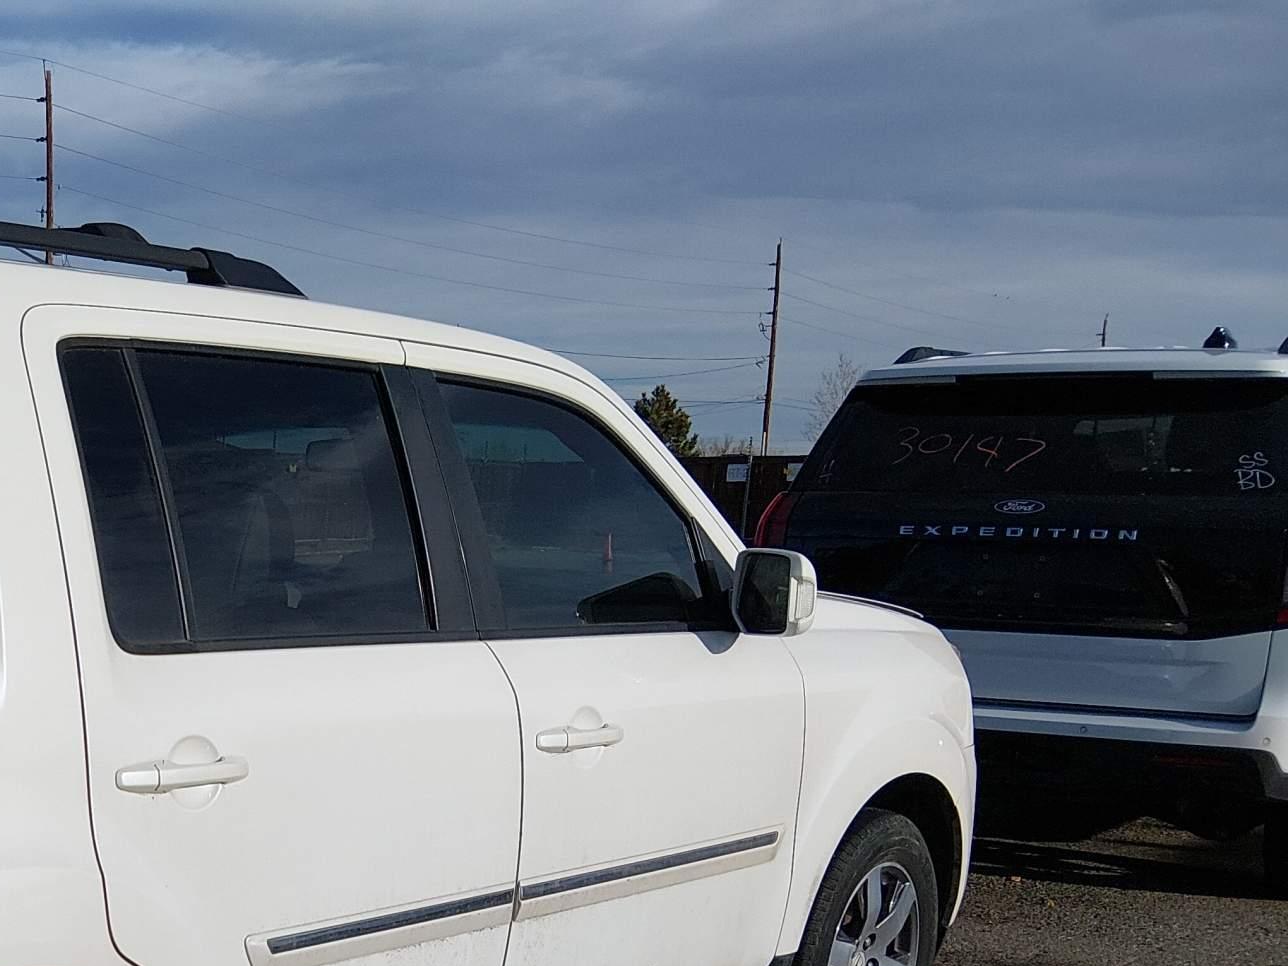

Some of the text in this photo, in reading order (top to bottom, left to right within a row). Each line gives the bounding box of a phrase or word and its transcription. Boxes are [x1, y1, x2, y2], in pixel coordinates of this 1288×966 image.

[892, 426, 1046, 472] 30147
[1238, 451, 1269, 469] SS
[1001, 500, 1037, 512] Ford
[899, 525, 1138, 541] EXPEDITION
